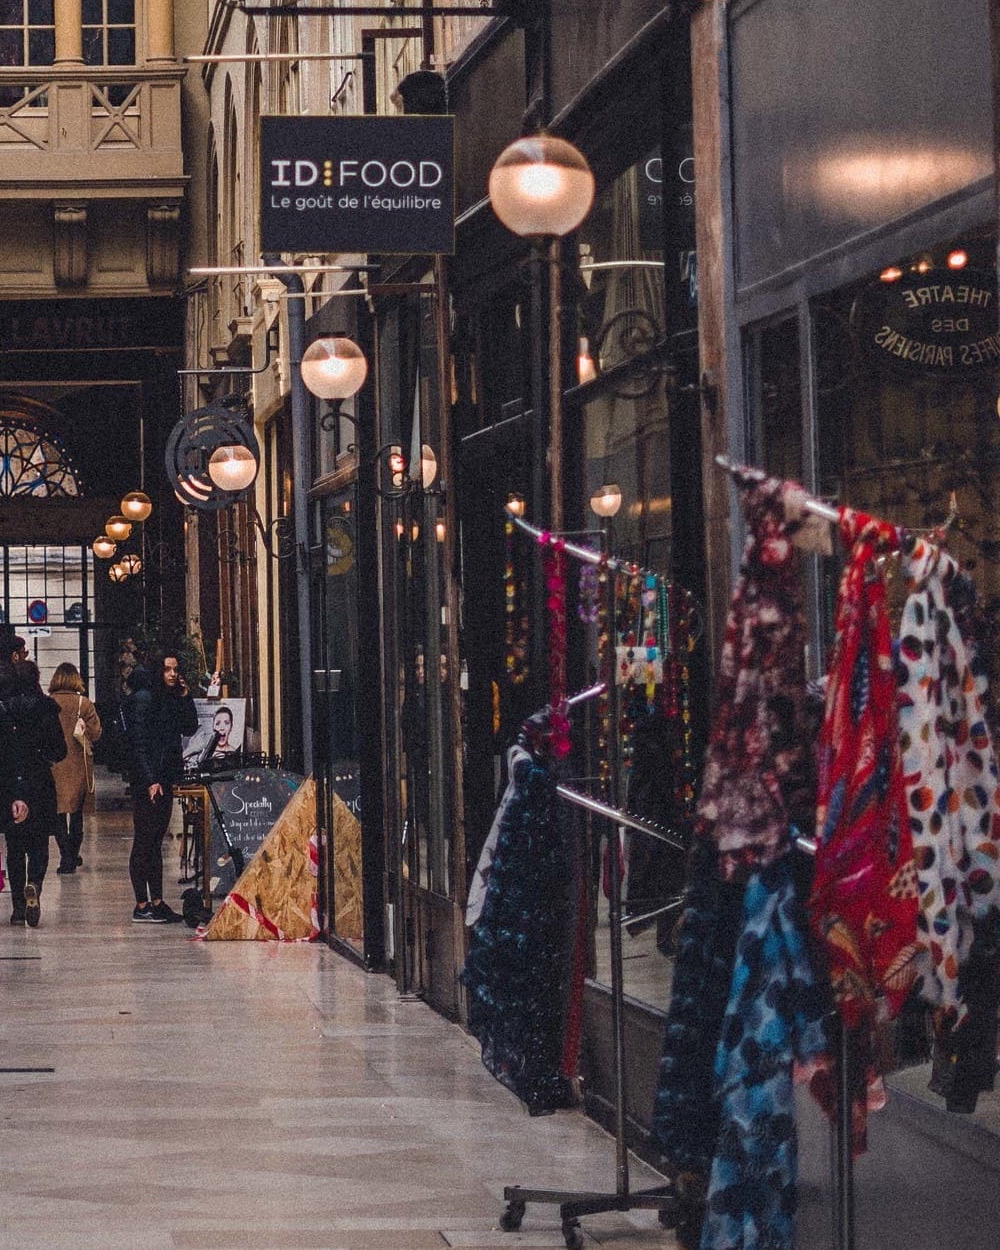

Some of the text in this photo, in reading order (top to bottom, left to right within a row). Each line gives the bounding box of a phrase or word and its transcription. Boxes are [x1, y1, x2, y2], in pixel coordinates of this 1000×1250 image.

[271, 195, 442, 211] Le goût de l'équilibre
